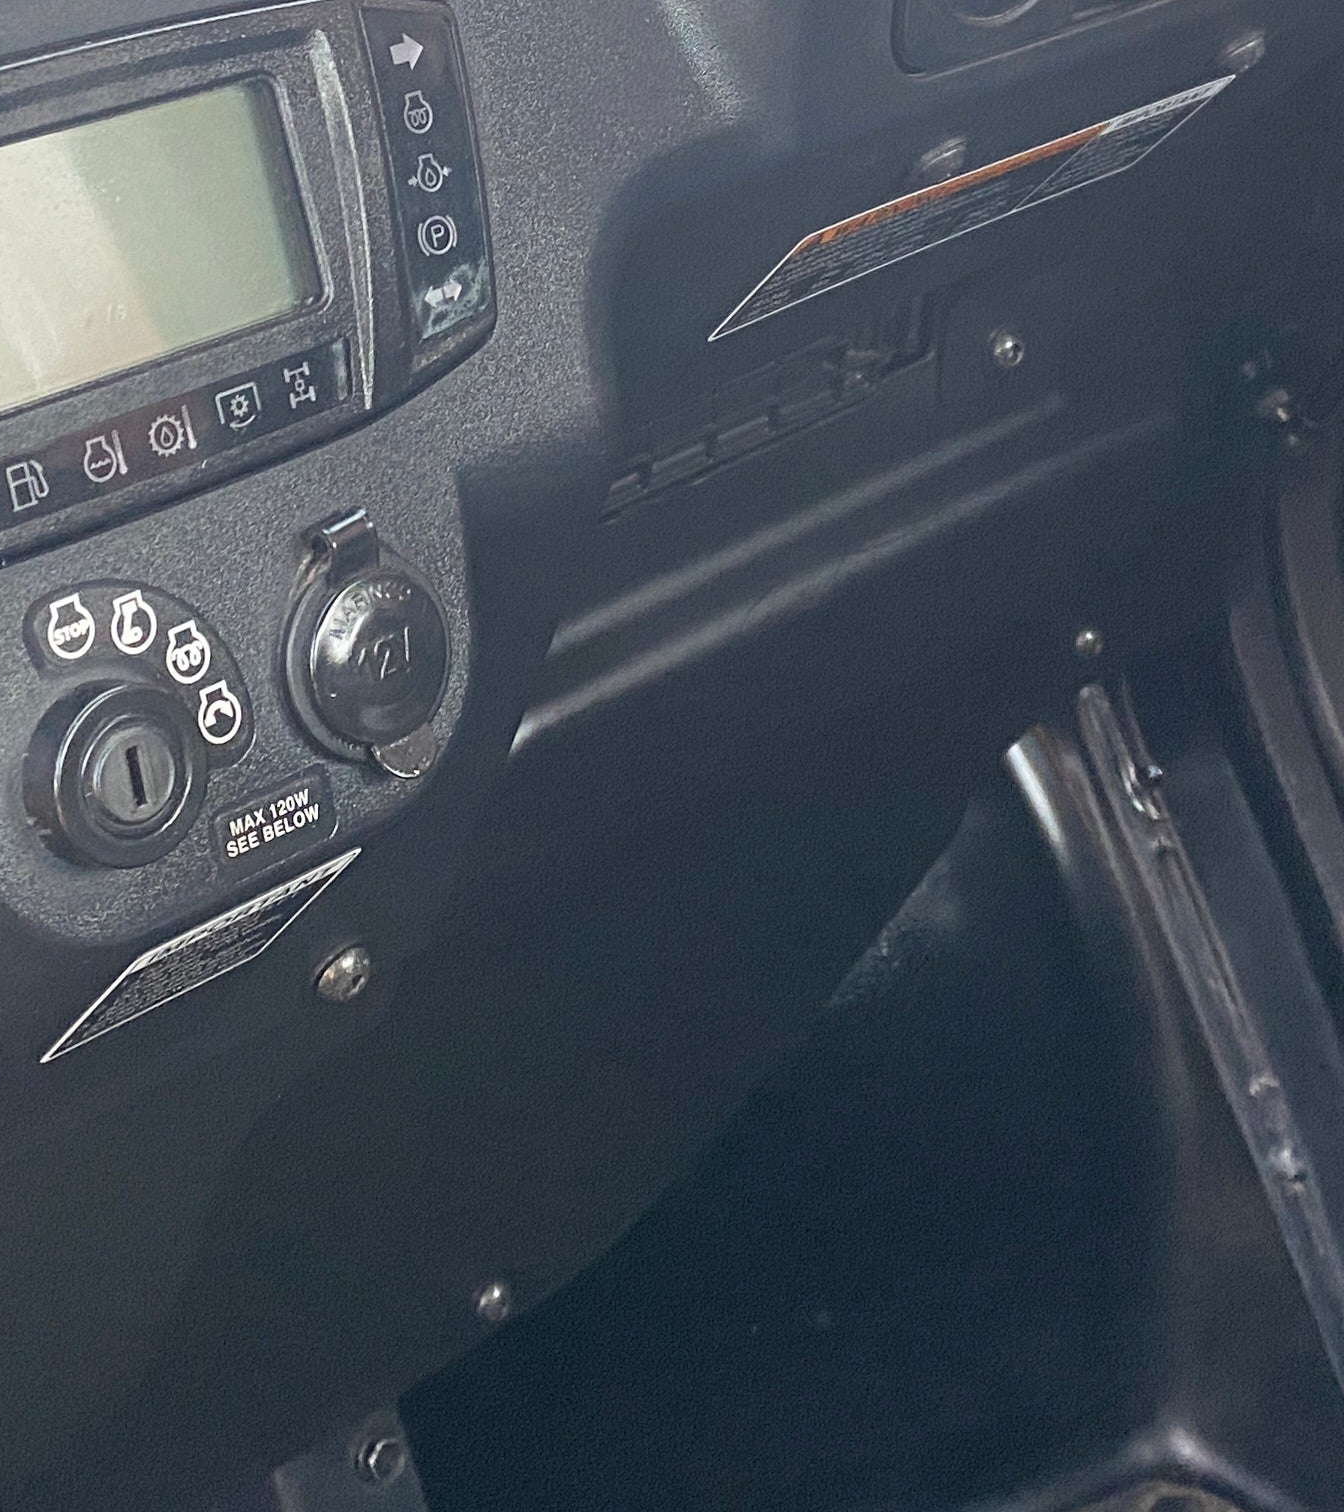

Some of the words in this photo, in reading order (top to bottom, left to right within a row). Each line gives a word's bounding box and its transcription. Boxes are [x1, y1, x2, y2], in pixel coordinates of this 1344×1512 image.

[53, 621, 89, 646] STOP
[225, 832, 260, 858] SEE
[262, 805, 320, 845] BELOW
[229, 806, 267, 838] MAX
[268, 788, 311, 821] 120W
